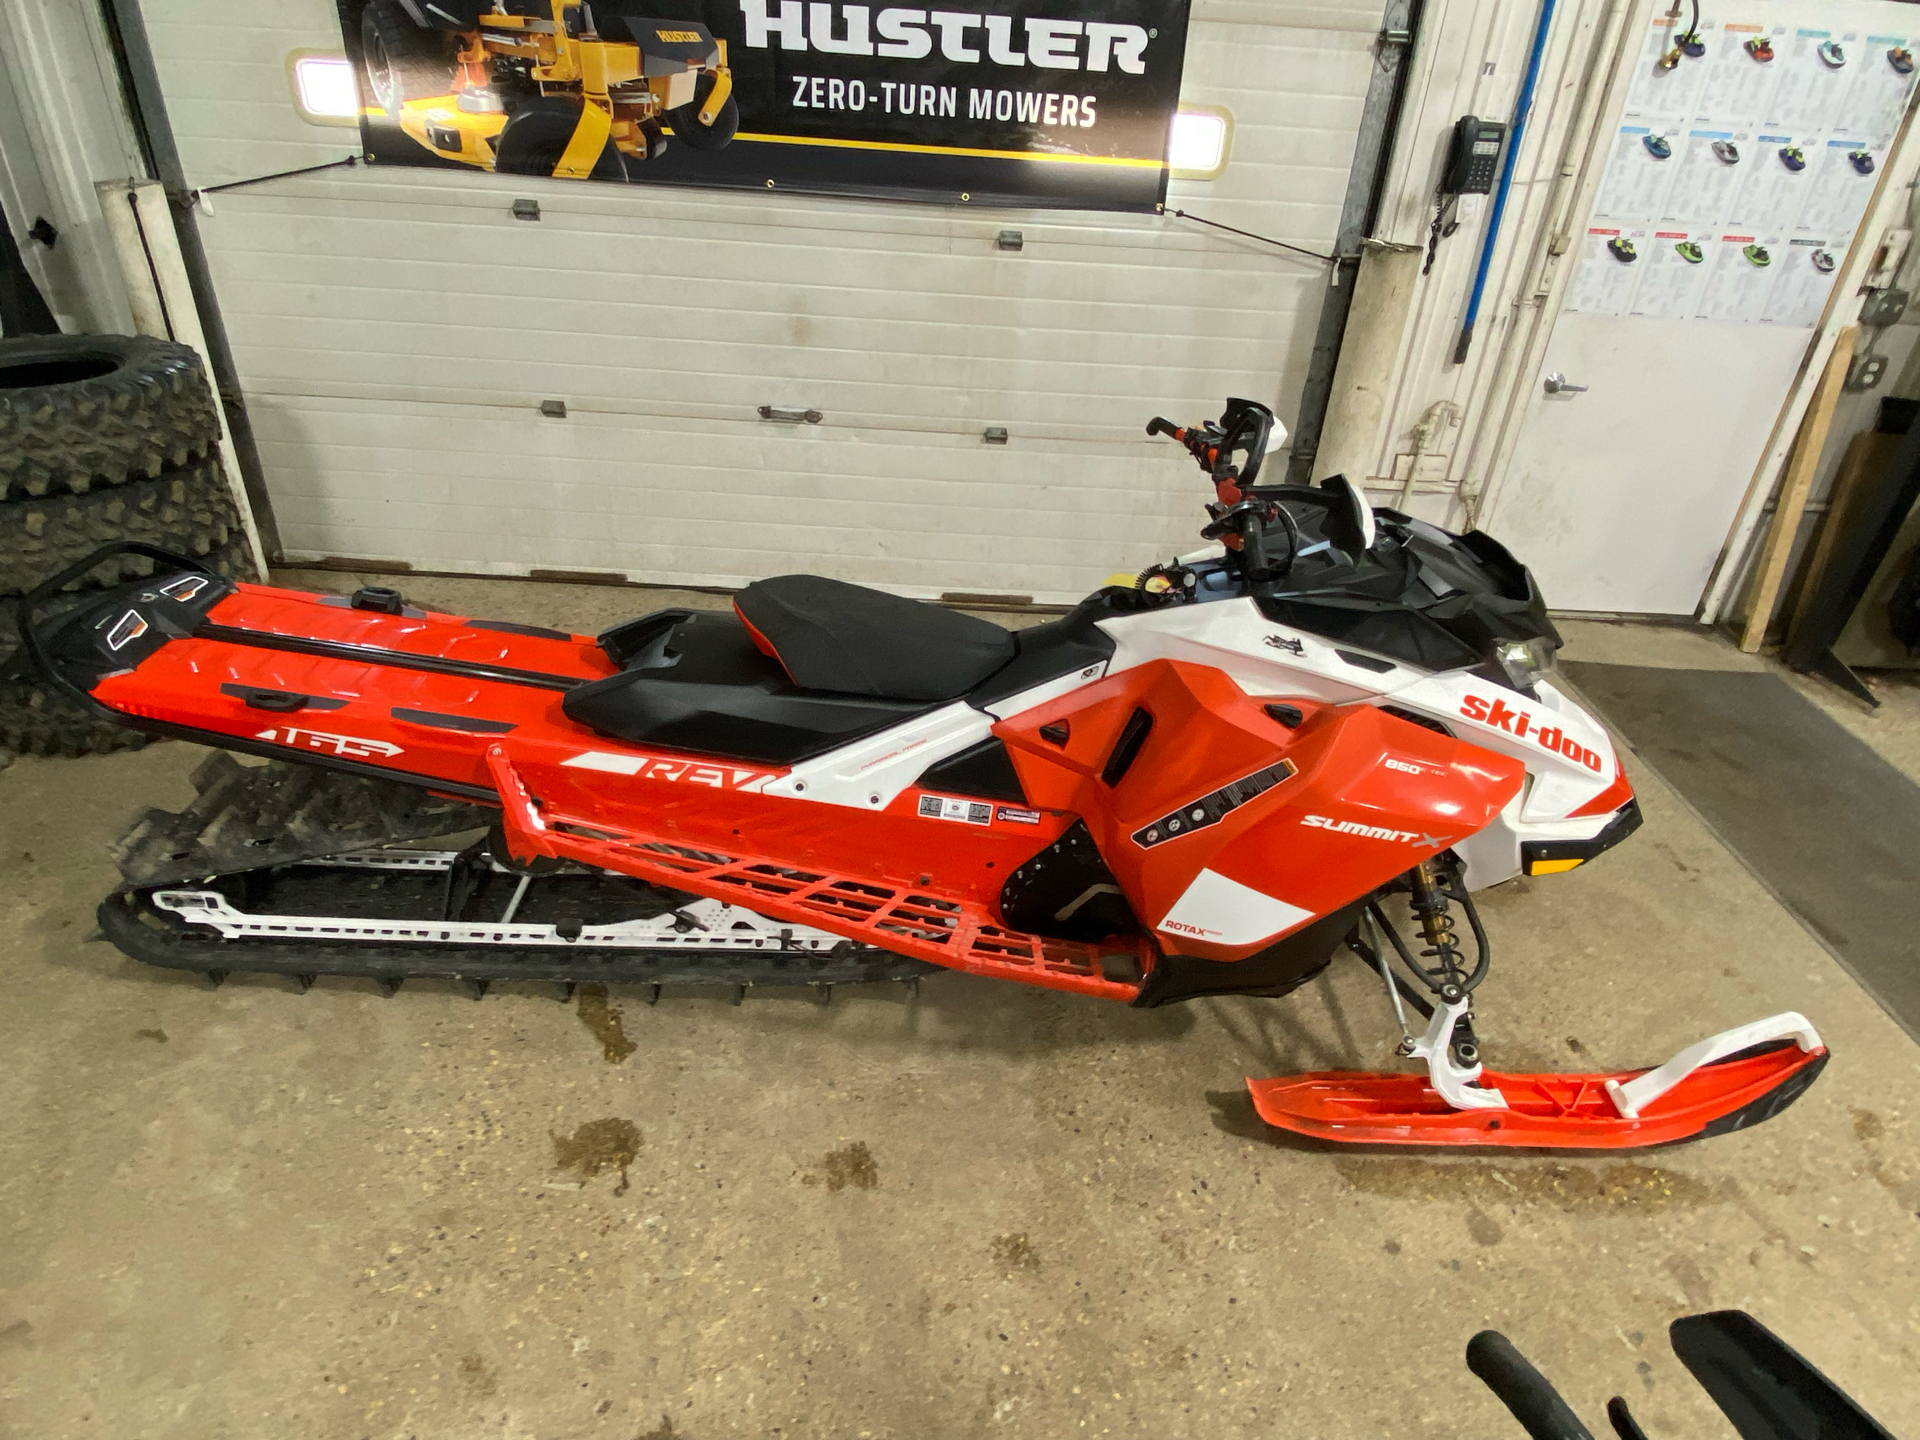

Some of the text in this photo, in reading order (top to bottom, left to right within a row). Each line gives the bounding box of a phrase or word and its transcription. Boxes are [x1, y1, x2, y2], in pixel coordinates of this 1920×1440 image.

[655, 29, 703, 43] HUSTLER
[740, 0, 1148, 75] HUSTLER
[792, 75, 1097, 128] ZERO-TURN MOWERS
[1460, 694, 1602, 773] ski-doo
[634, 758, 768, 793] REV
[1384, 758, 1421, 775] 850
[1300, 814, 1453, 849] SUMMIT X
[1165, 919, 1206, 937] ROTAX
